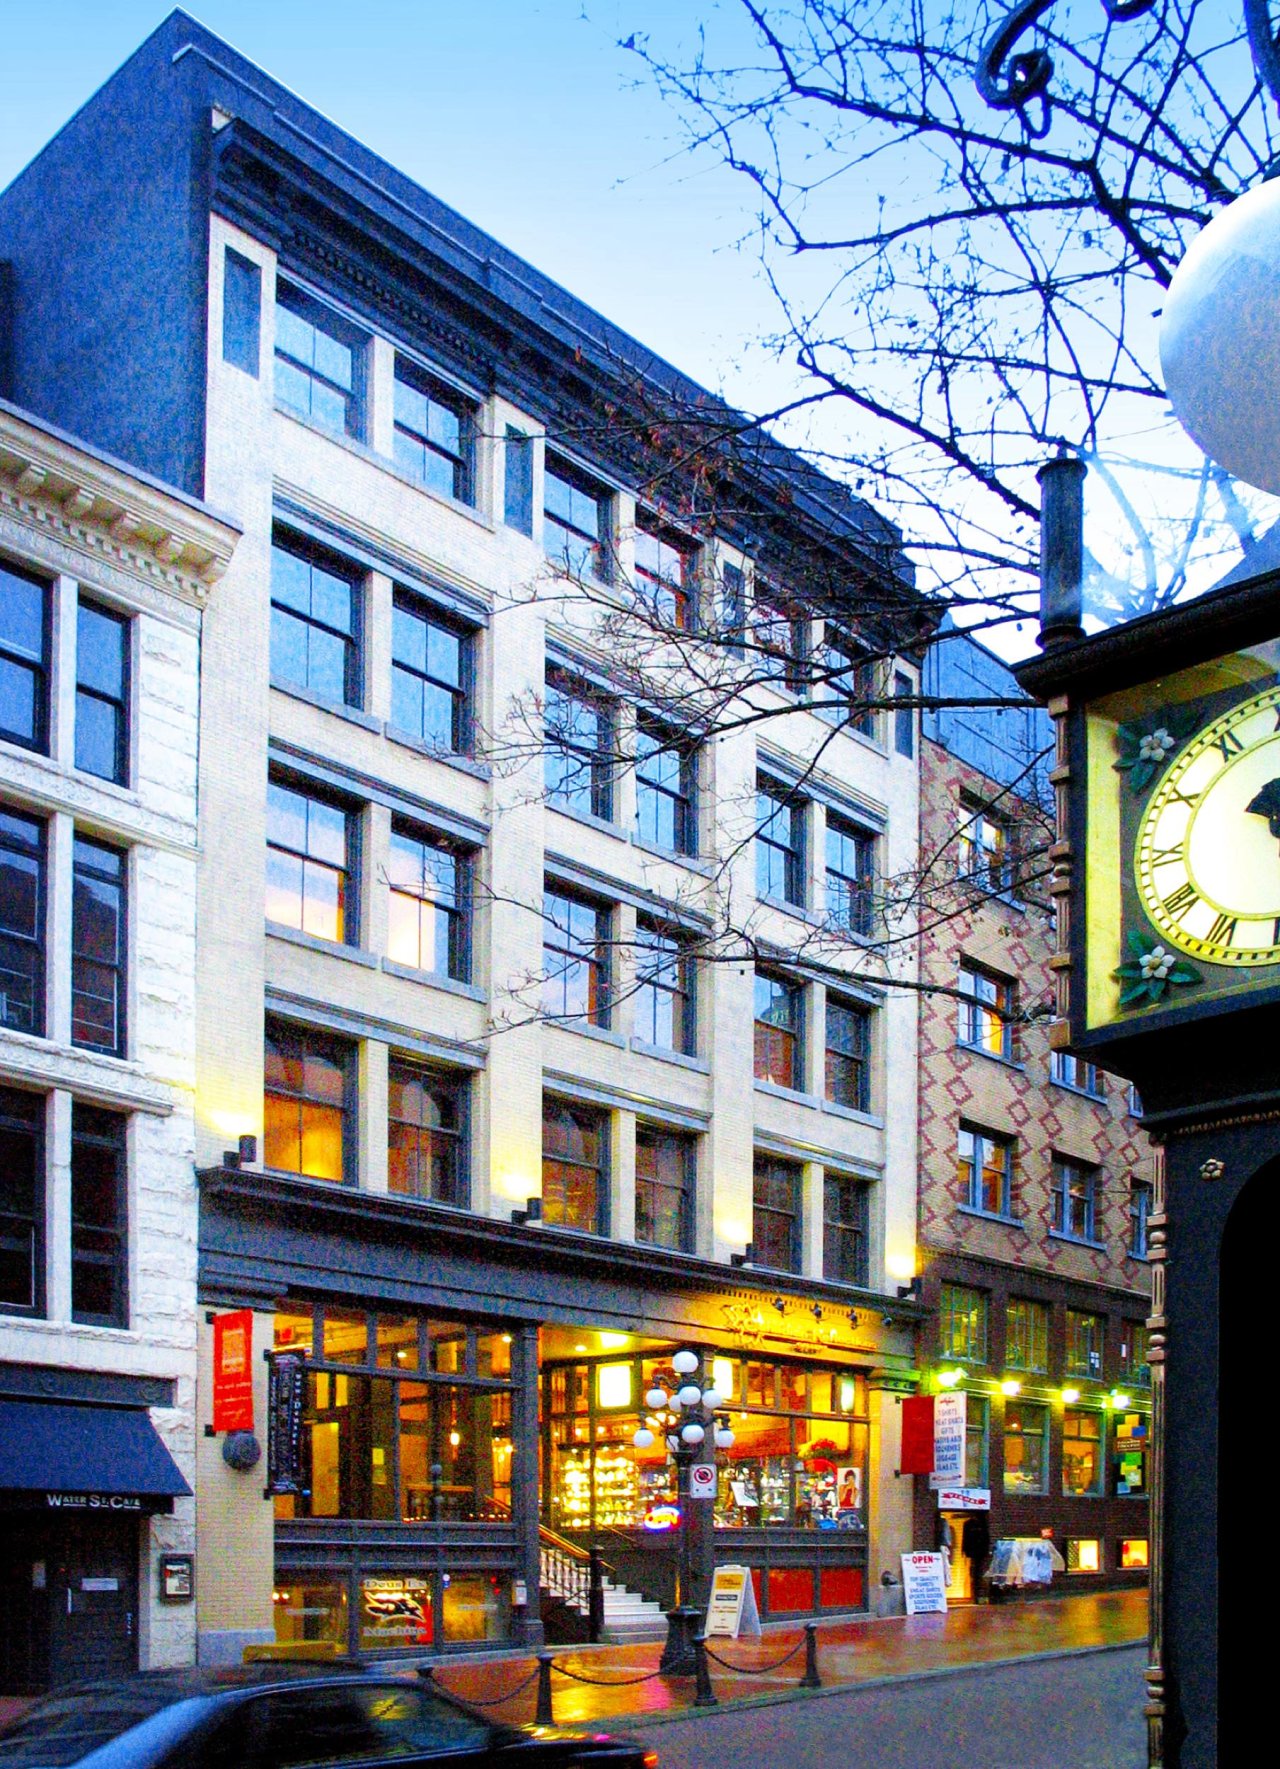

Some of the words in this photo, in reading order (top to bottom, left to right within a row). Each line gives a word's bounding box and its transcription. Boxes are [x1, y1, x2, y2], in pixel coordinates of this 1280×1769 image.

[1211, 730, 1244, 763] XI
[1166, 786, 1200, 809] X
[912, 1555, 934, 1564] OPEN
